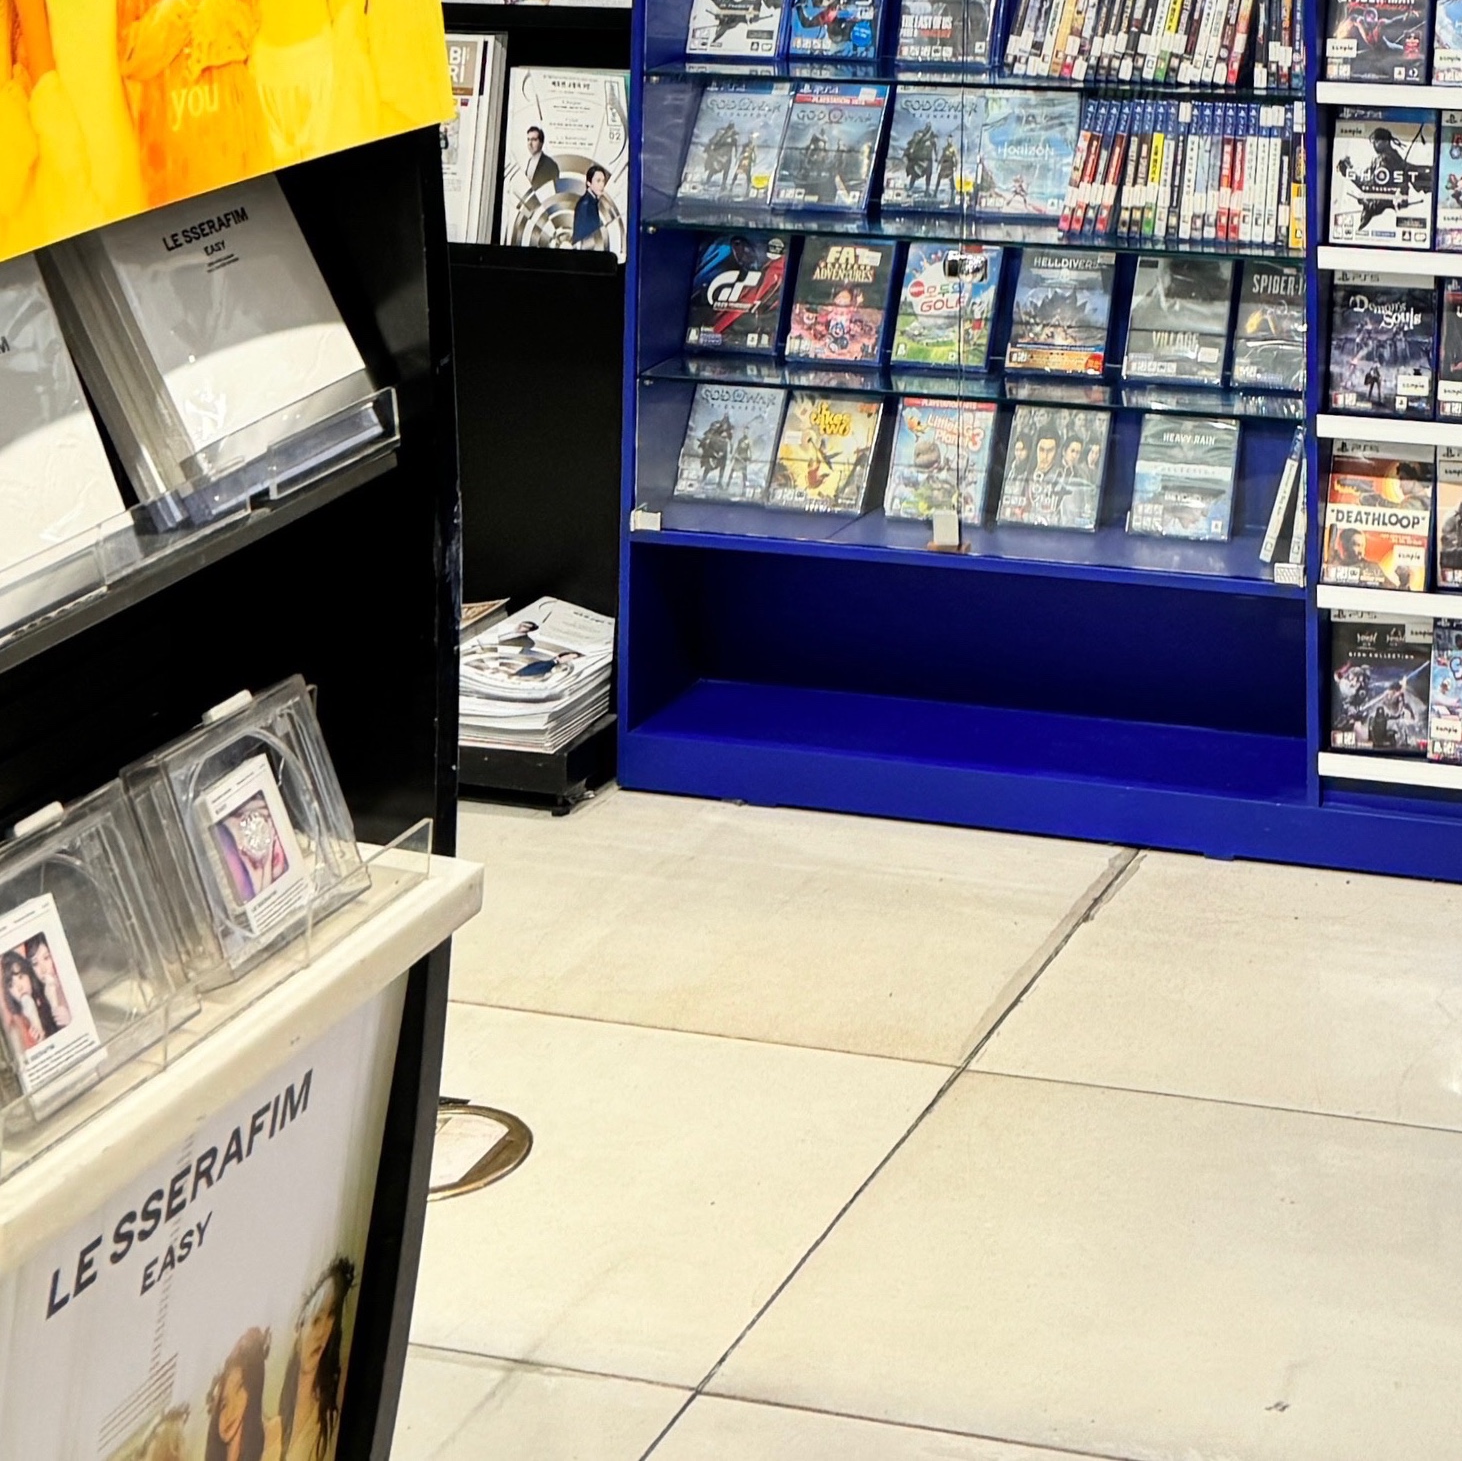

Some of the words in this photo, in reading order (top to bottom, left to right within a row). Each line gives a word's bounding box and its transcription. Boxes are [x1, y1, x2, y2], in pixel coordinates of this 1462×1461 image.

[996, 143, 1055, 160] HORIZON
[1345, 168, 1419, 184] GHOST
[162, 232, 184, 252] LE
[181, 206, 249, 244] SSERAFIM
[812, 267, 875, 283] ADVENTURES
[1351, 273, 1380, 283] PS5
[1252, 273, 1306, 296] SPIDER-
[920, 296, 966, 313] GOLF
[1379, 308, 1422, 329] Souls
[1163, 432, 1192, 444] HEAVY
[1193, 435, 1215, 446] RAIN
[45, 1235, 103, 1321] LE
[110, 1068, 313, 1266] SSERAFIM
[140, 1210, 213, 1297] EASY
